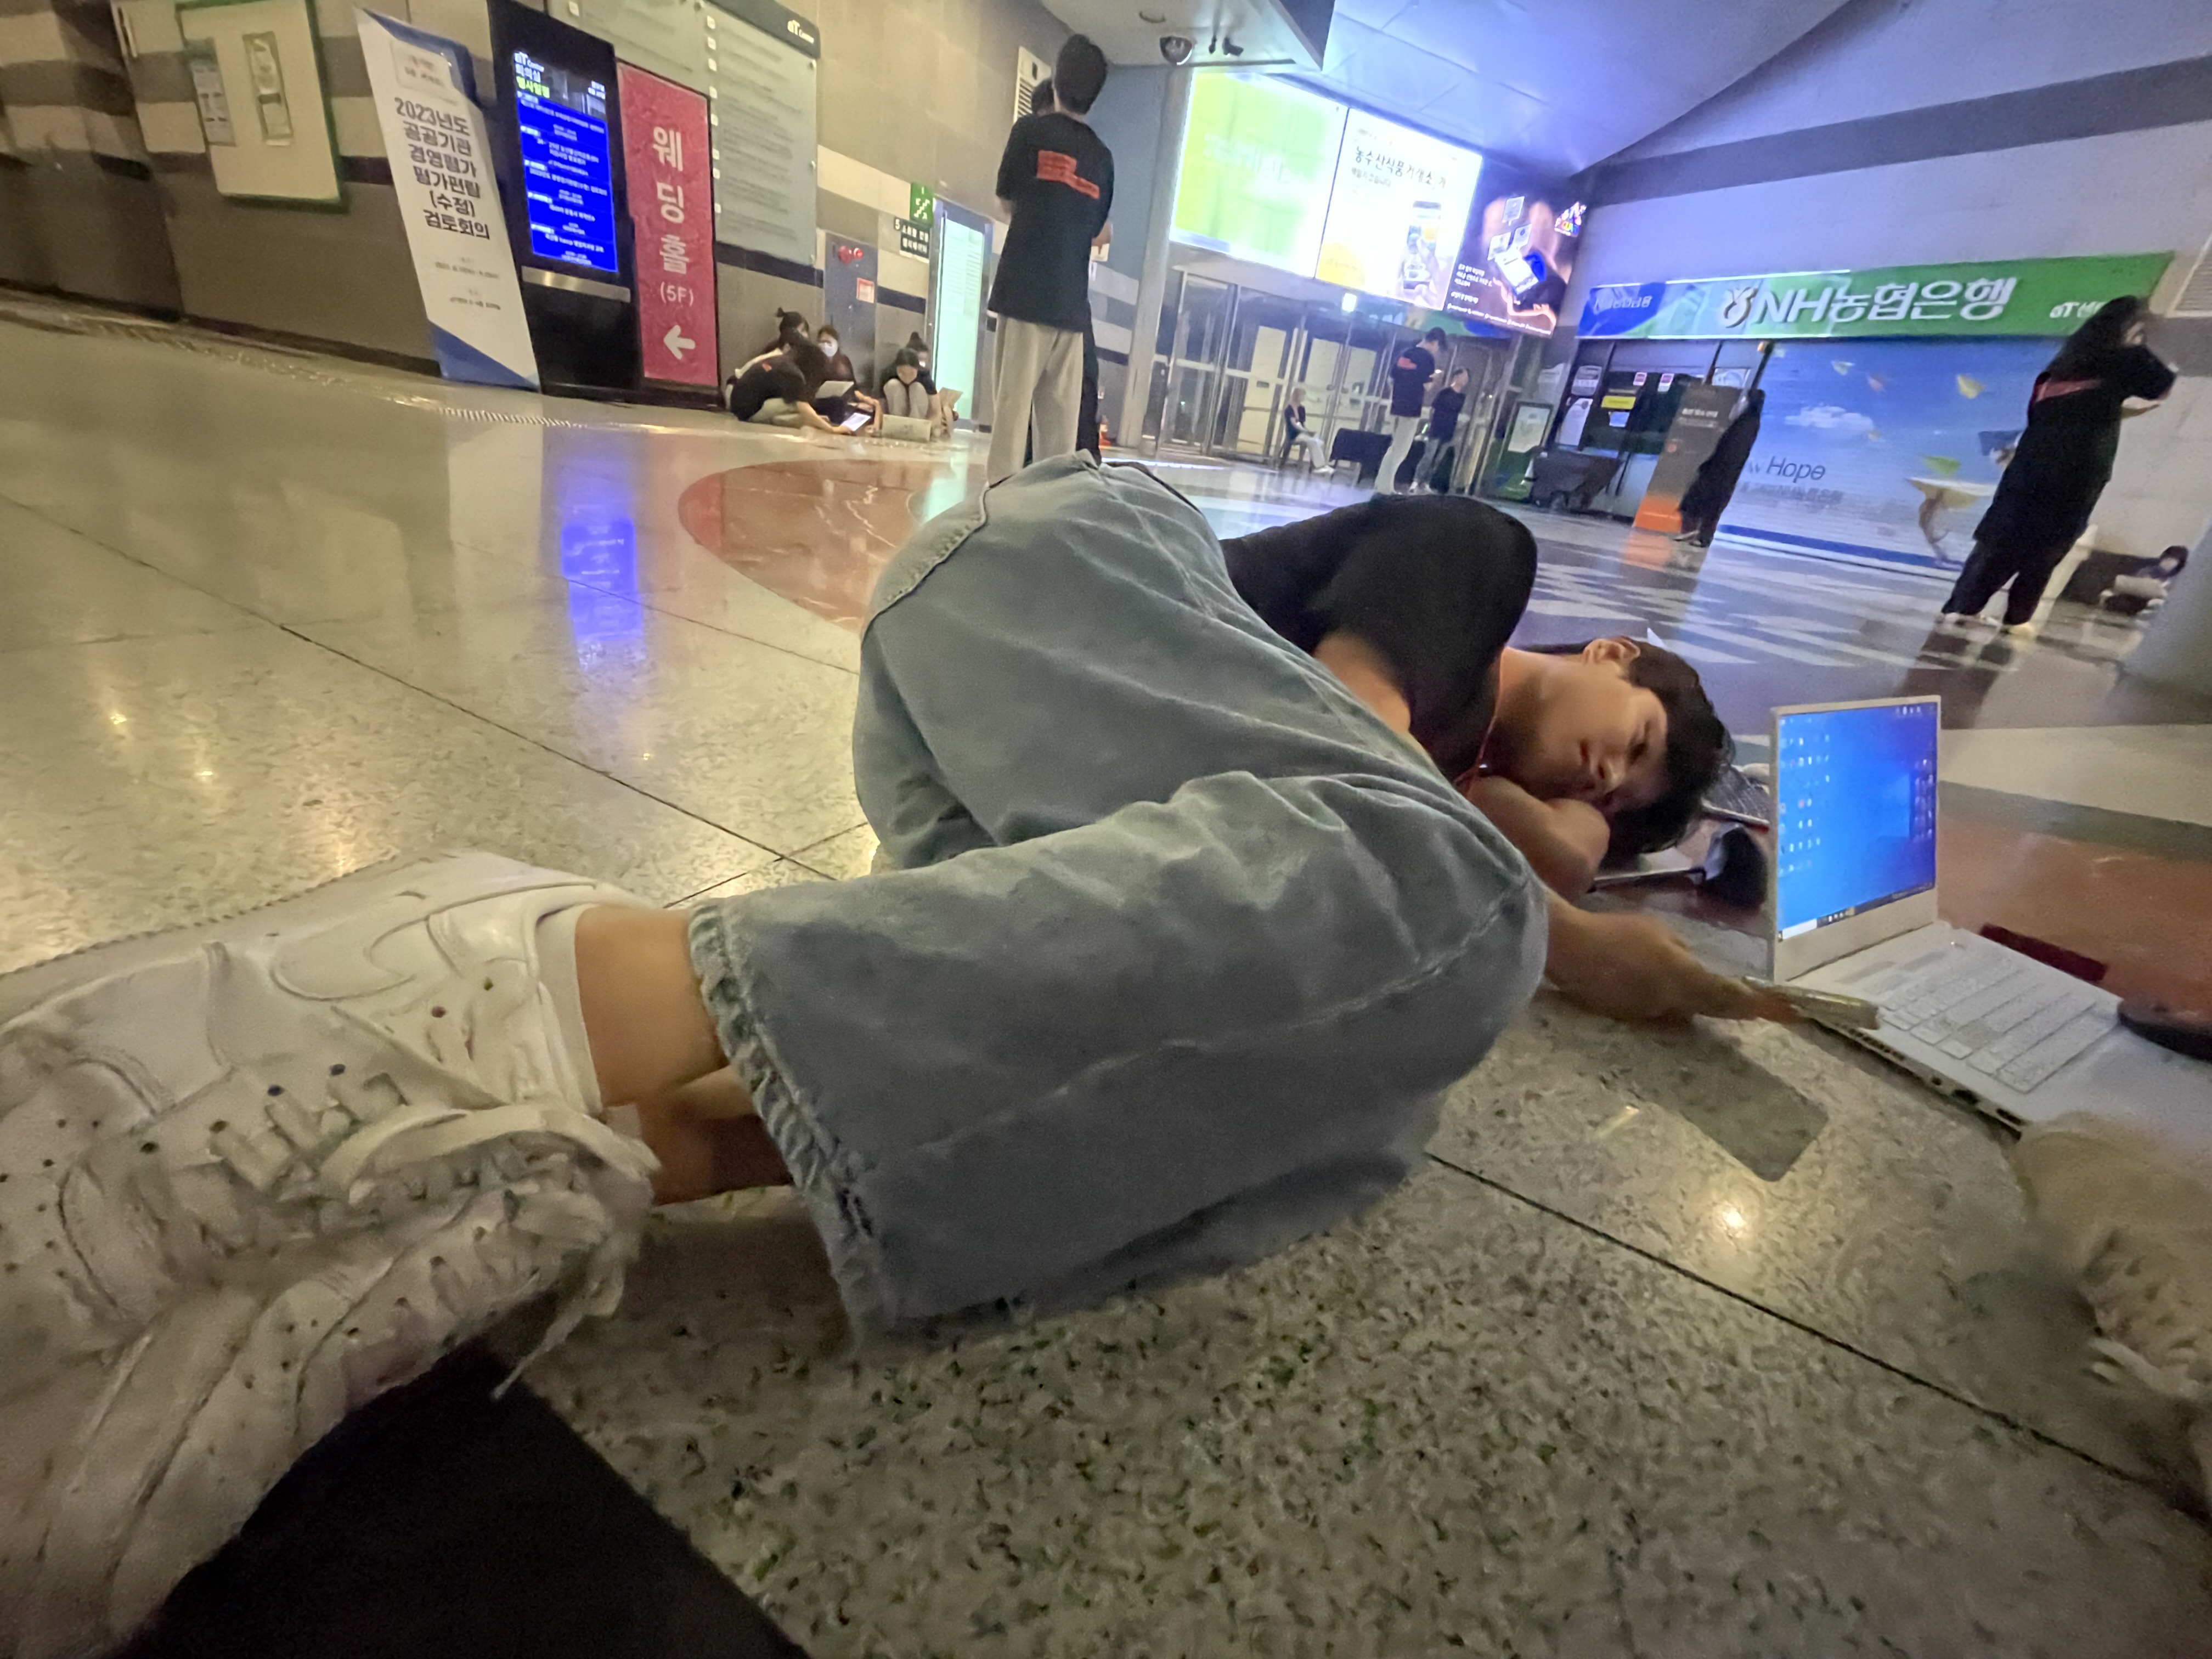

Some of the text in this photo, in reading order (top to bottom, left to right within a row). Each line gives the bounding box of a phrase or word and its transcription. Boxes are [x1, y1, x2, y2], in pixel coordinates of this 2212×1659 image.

[394, 97, 471, 136] 2023년도
[403, 120, 472, 157] 공공기관
[408, 143, 477, 178] 경영평가
[413, 165, 481, 199] 평가편람
[429, 190, 476, 218] (수정)
[653, 126, 690, 274] 웨딩홀
[423, 209, 490, 240] 검토회의
[660, 281, 694, 307] (5F)
[1767, 455, 1826, 484] Hope
